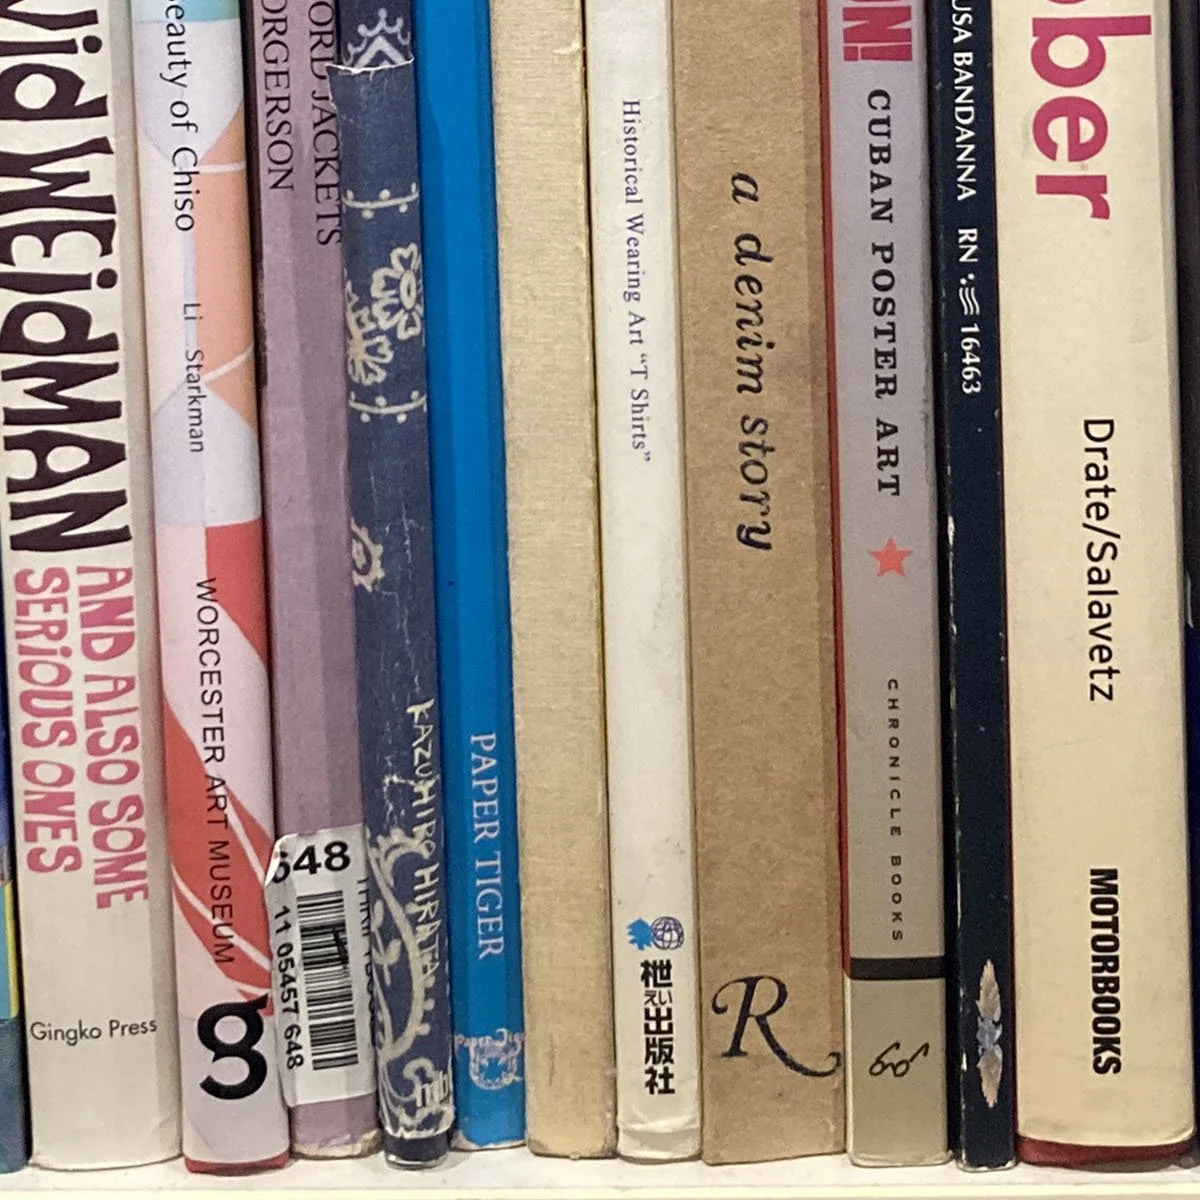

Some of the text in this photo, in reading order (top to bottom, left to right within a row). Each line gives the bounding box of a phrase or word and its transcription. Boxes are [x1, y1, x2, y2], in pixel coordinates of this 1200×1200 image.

[169, 100, 199, 133] of
[309, 89, 344, 246] JACKETS
[622, 99, 644, 207] Historical
[952, 53, 978, 202] BANDANNA
[170, 146, 202, 232] Chiso
[958, 227, 980, 264] RN
[622, 214, 648, 304] Wearing
[867, 89, 902, 498] CUBAN POSTER ART
[183, 302, 206, 454] Li Starkman
[627, 310, 649, 347] Art
[731, 171, 776, 553] a denim story
[958, 323, 982, 396] 16463
[1082, 416, 1122, 703] Drate/Salavetz
[77, 565, 150, 910] AND ALSO SOME
[195, 578, 236, 964] WORCESTER ART MUSEUM
[22, 760, 84, 874] ONES
[469, 732, 506, 960] PAPER TIGER
[886, 678, 904, 942] CHRONICLE BOOKS
[411, 863, 442, 980] HIRATA
[1090, 867, 1123, 1075] MOTORBOOKS
[30, 1016, 158, 1047] Gingko Press
[198, 993, 269, 1100] g
[274, 906, 305, 1071] 11 05457 648
[712, 975, 843, 1078] R
